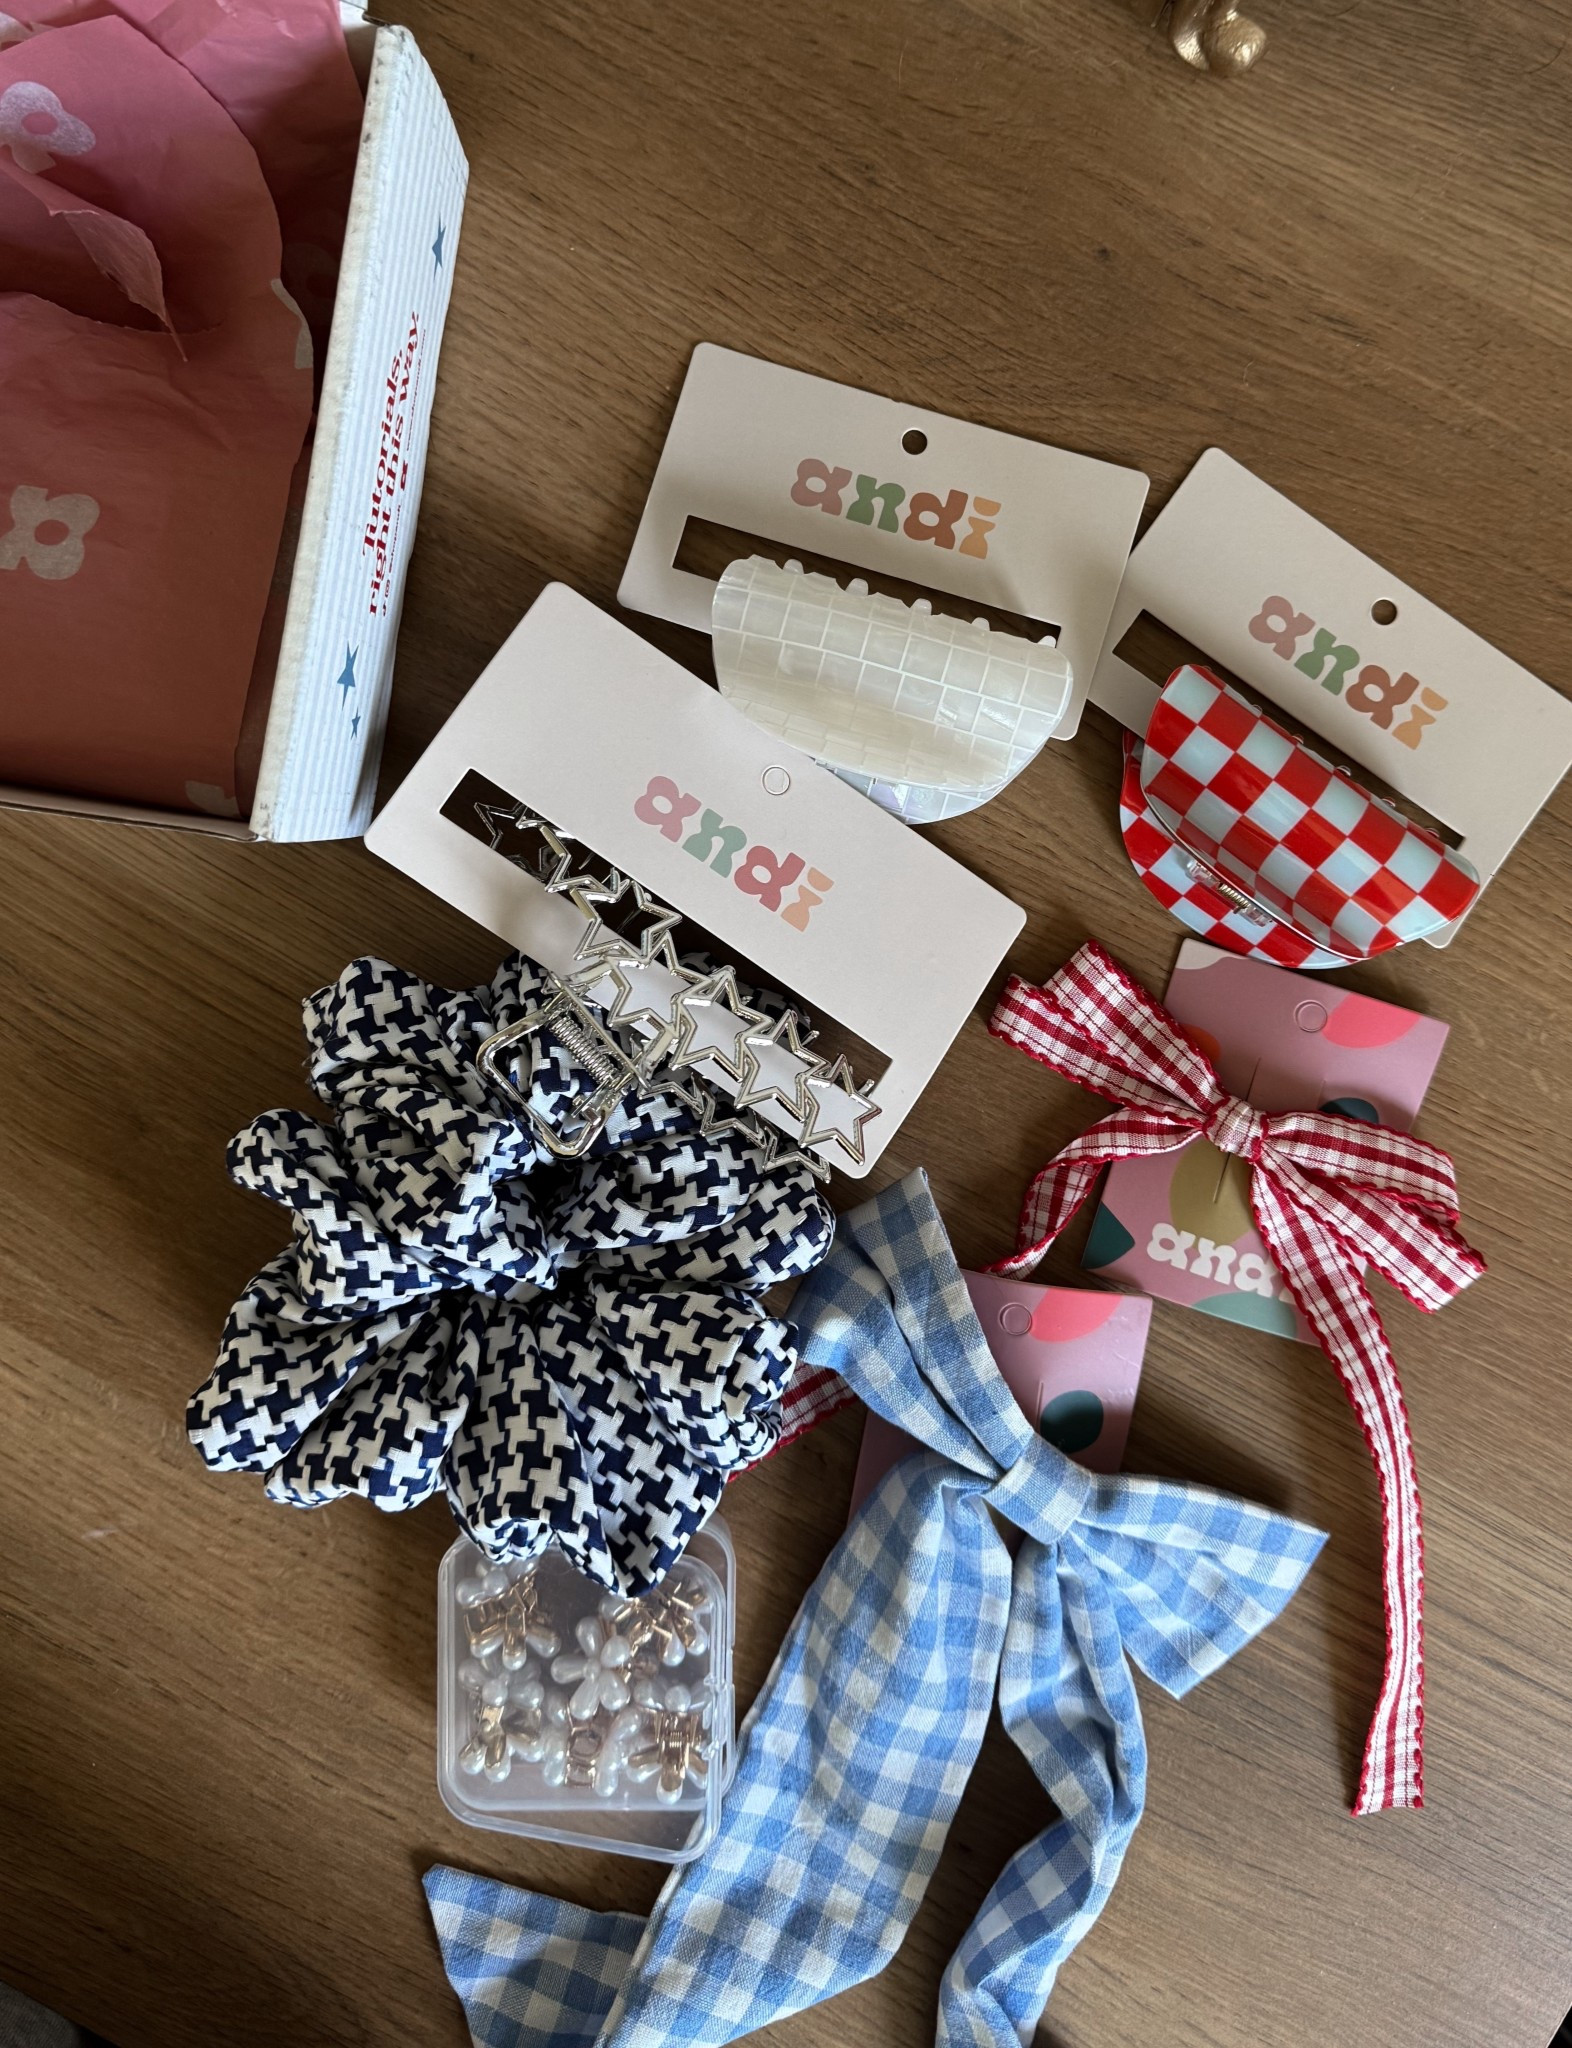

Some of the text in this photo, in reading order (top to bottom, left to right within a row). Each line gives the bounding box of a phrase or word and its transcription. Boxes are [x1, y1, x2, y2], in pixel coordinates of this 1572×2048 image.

[362, 349, 402, 556] Tutorials,
[369, 311, 419, 616] right this way.
[790, 458, 1002, 560] andi
[1248, 595, 1449, 751] andi
[633, 775, 835, 933] andi
